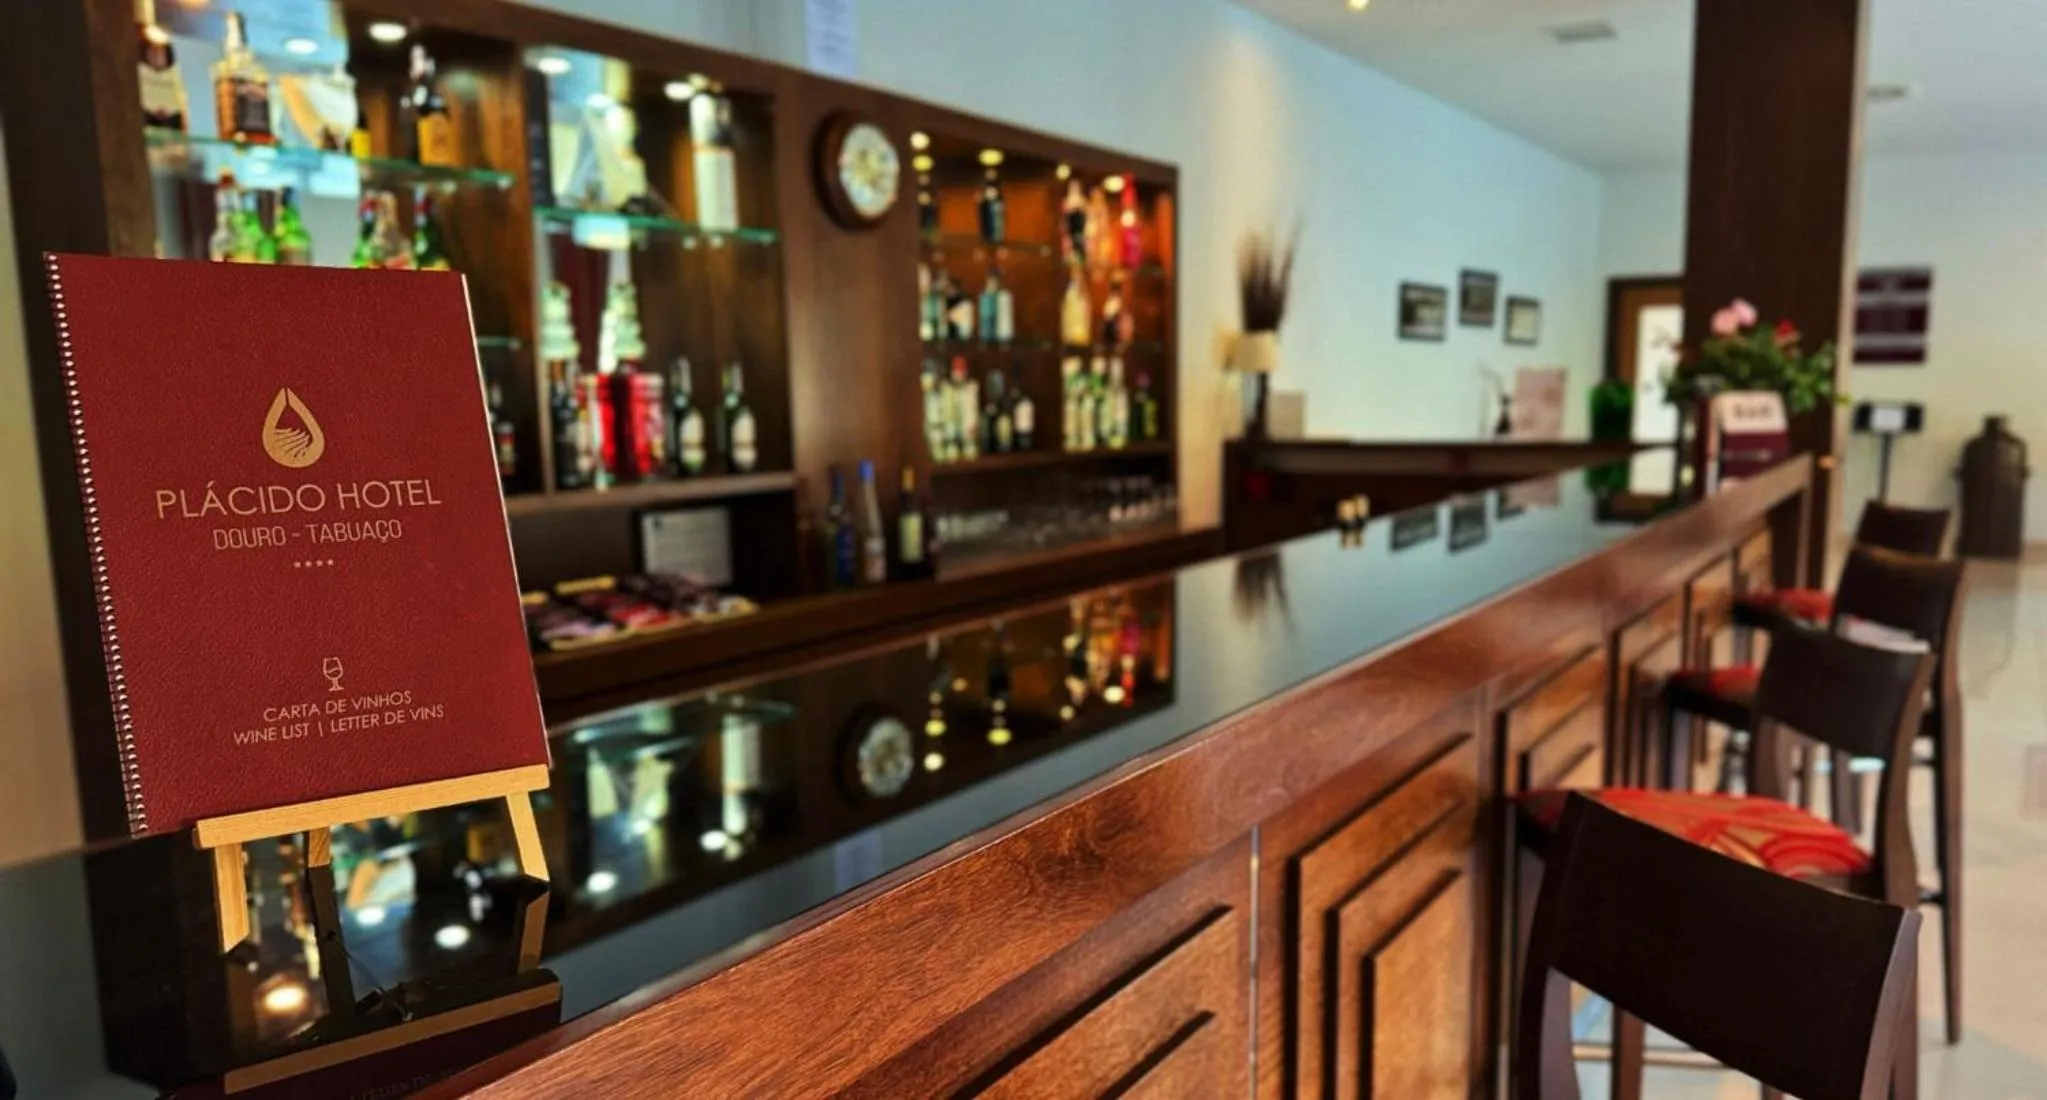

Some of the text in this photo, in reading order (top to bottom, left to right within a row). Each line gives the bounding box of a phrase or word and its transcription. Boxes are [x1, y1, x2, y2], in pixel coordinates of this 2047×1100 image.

[155, 479, 442, 519] PLÁCIDO HOTEL
[212, 525, 287, 550] DOURO
[305, 519, 403, 543] TABUAÇO
[263, 690, 412, 722] CARTA DE VINHOS
[233, 726, 278, 745] WINE
[281, 722, 310, 740] LIST
[330, 713, 380, 733] LETTER
[384, 709, 406, 726] DE
[409, 704, 445, 721] VINS
